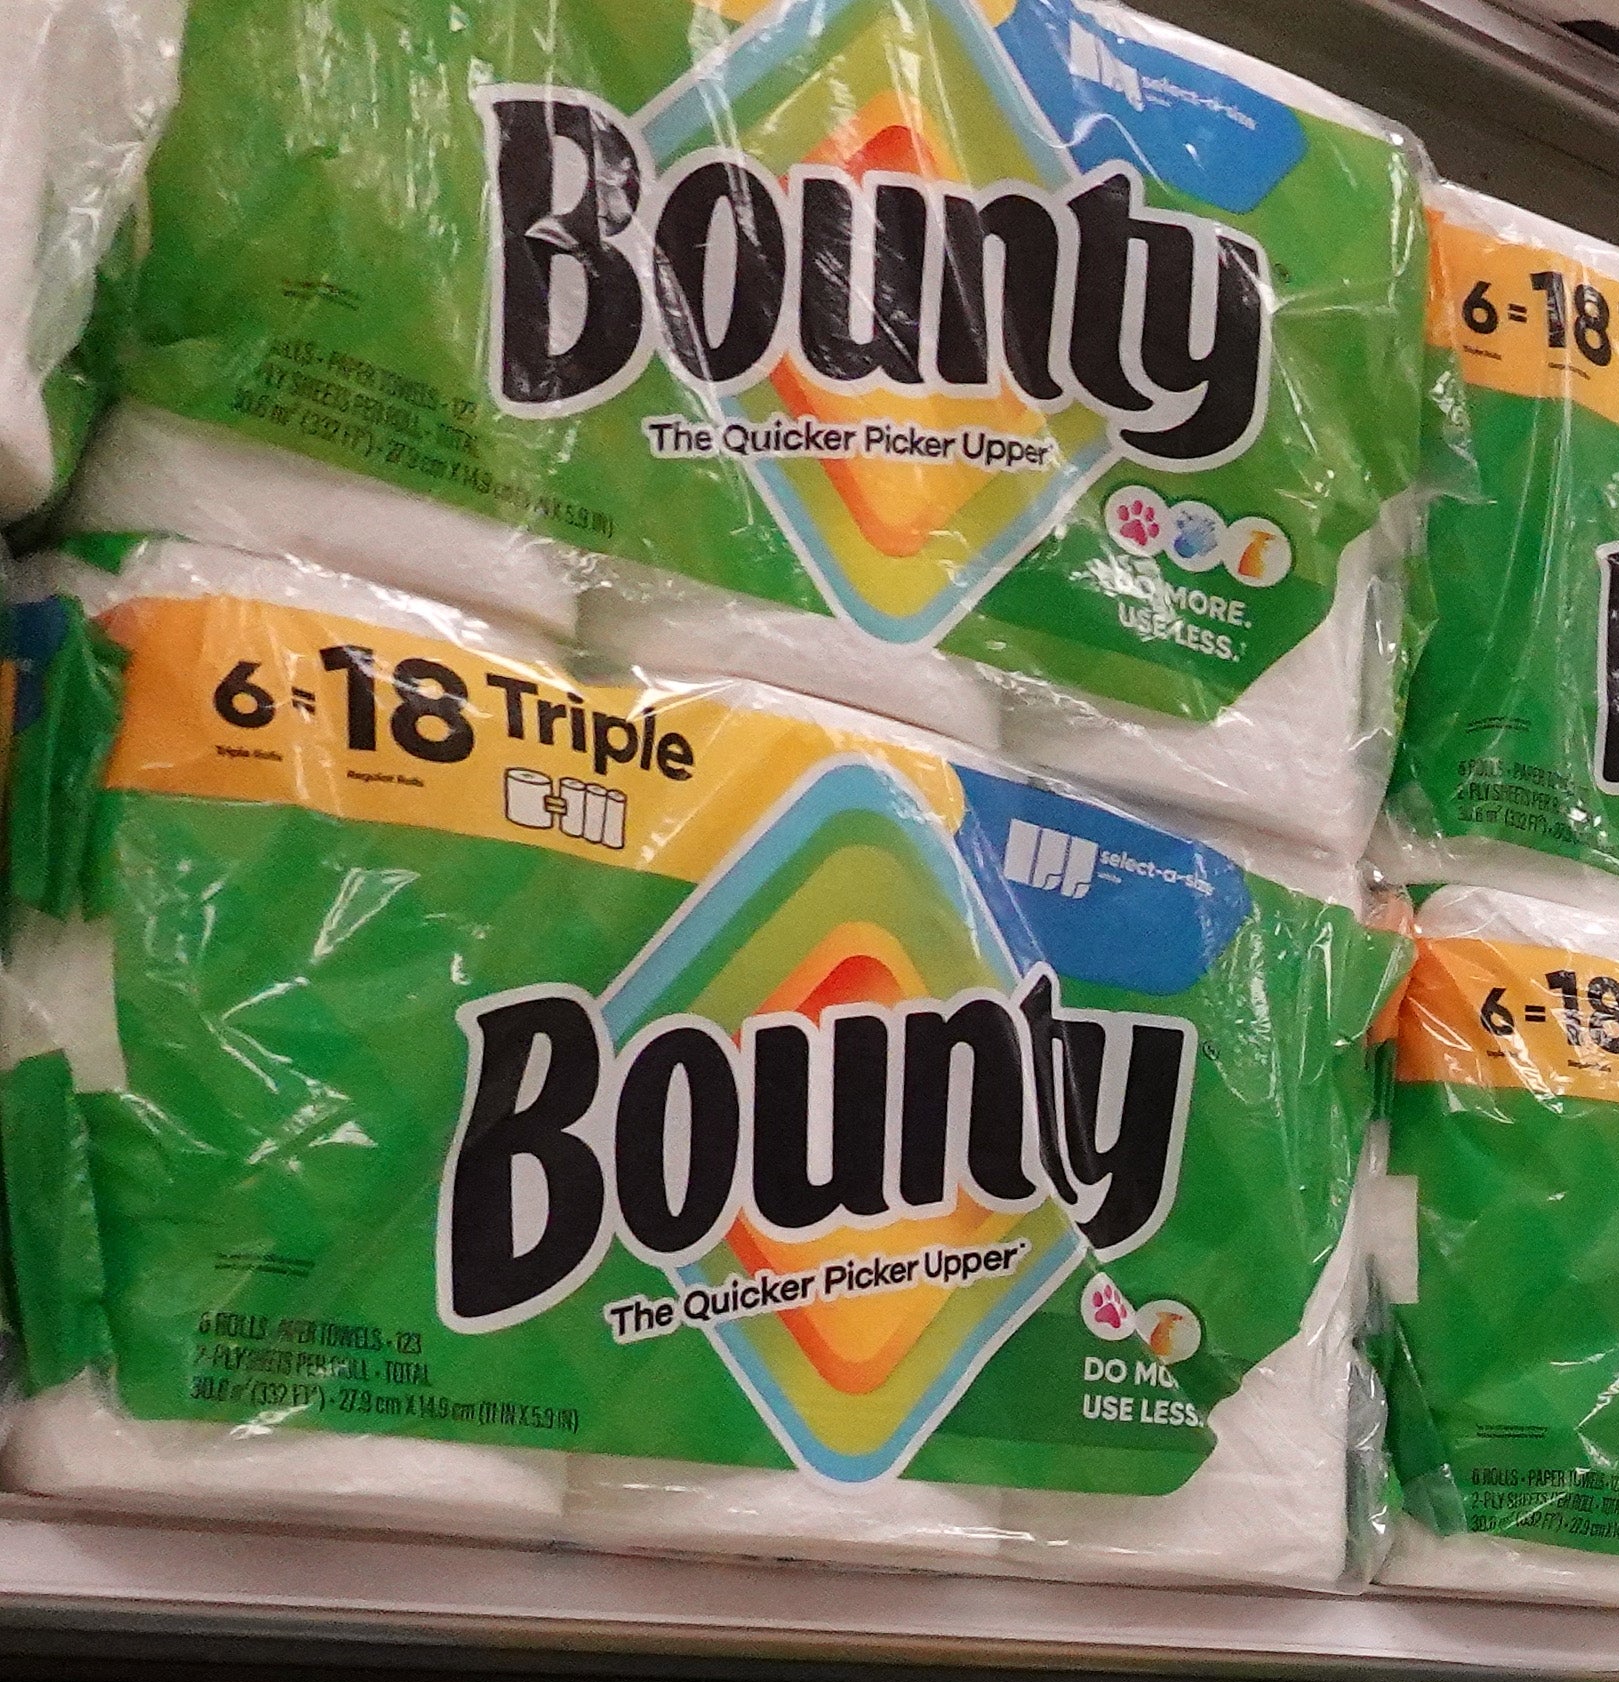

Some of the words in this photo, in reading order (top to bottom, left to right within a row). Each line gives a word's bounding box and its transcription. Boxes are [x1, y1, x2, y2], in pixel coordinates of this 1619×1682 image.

[493, 97, 1262, 462] Bounty
[649, 423, 712, 455] The
[721, 417, 857, 457] Quicker
[861, 427, 957, 458] Picker
[961, 431, 1050, 467] Upper
[487, 673, 695, 783] Triple
[451, 973, 1186, 1321] Bounty
[611, 1302, 673, 1336] The
[684, 1276, 814, 1321] Quicker
[824, 1258, 919, 1296] Picker
[1083, 1356, 1128, 1384] DO
[1083, 1393, 1135, 1422] USE
